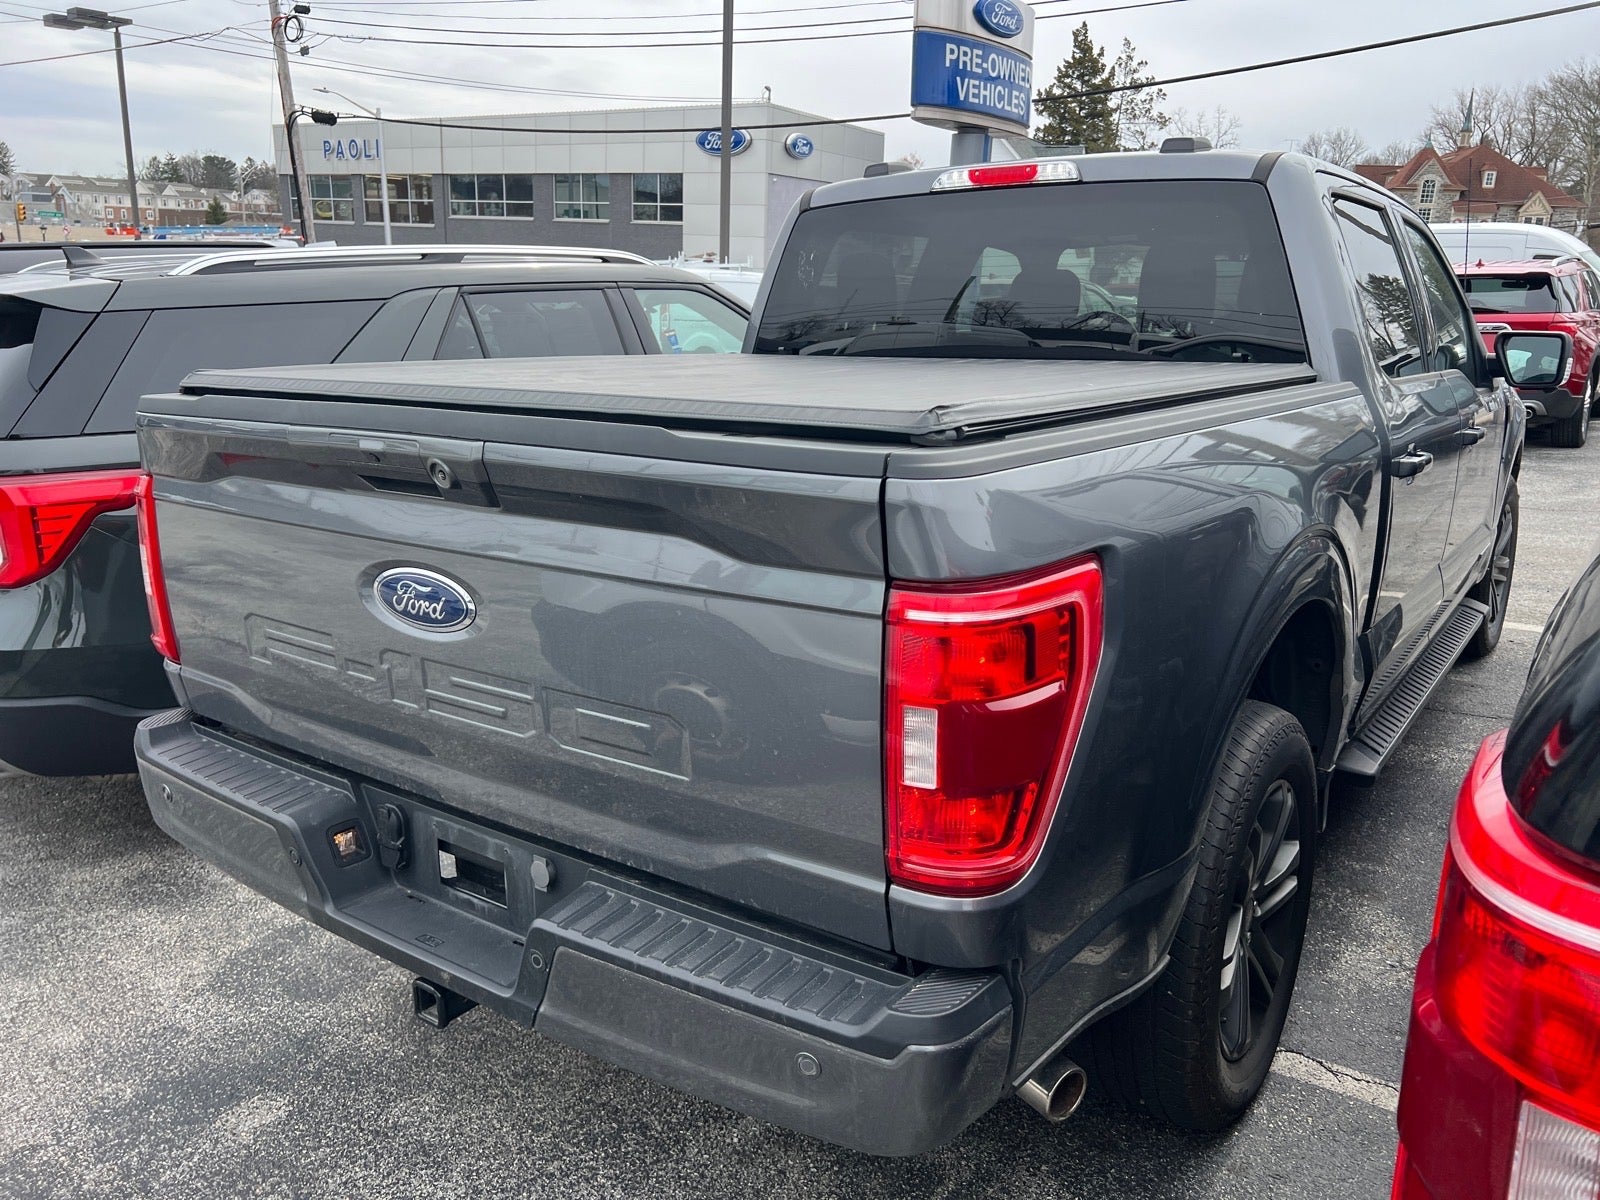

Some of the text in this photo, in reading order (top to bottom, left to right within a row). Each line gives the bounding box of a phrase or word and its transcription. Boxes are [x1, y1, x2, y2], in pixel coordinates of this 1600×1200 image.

[991, 2, 1018, 30] Ford
[945, 43, 1032, 89] PRE-OWNED
[956, 76, 1026, 116] VEHICLES
[323, 139, 379, 159] PAOLI
[795, 138, 810, 154] Ford
[392, 580, 446, 620] Ford
[244, 612, 691, 782] F-150
